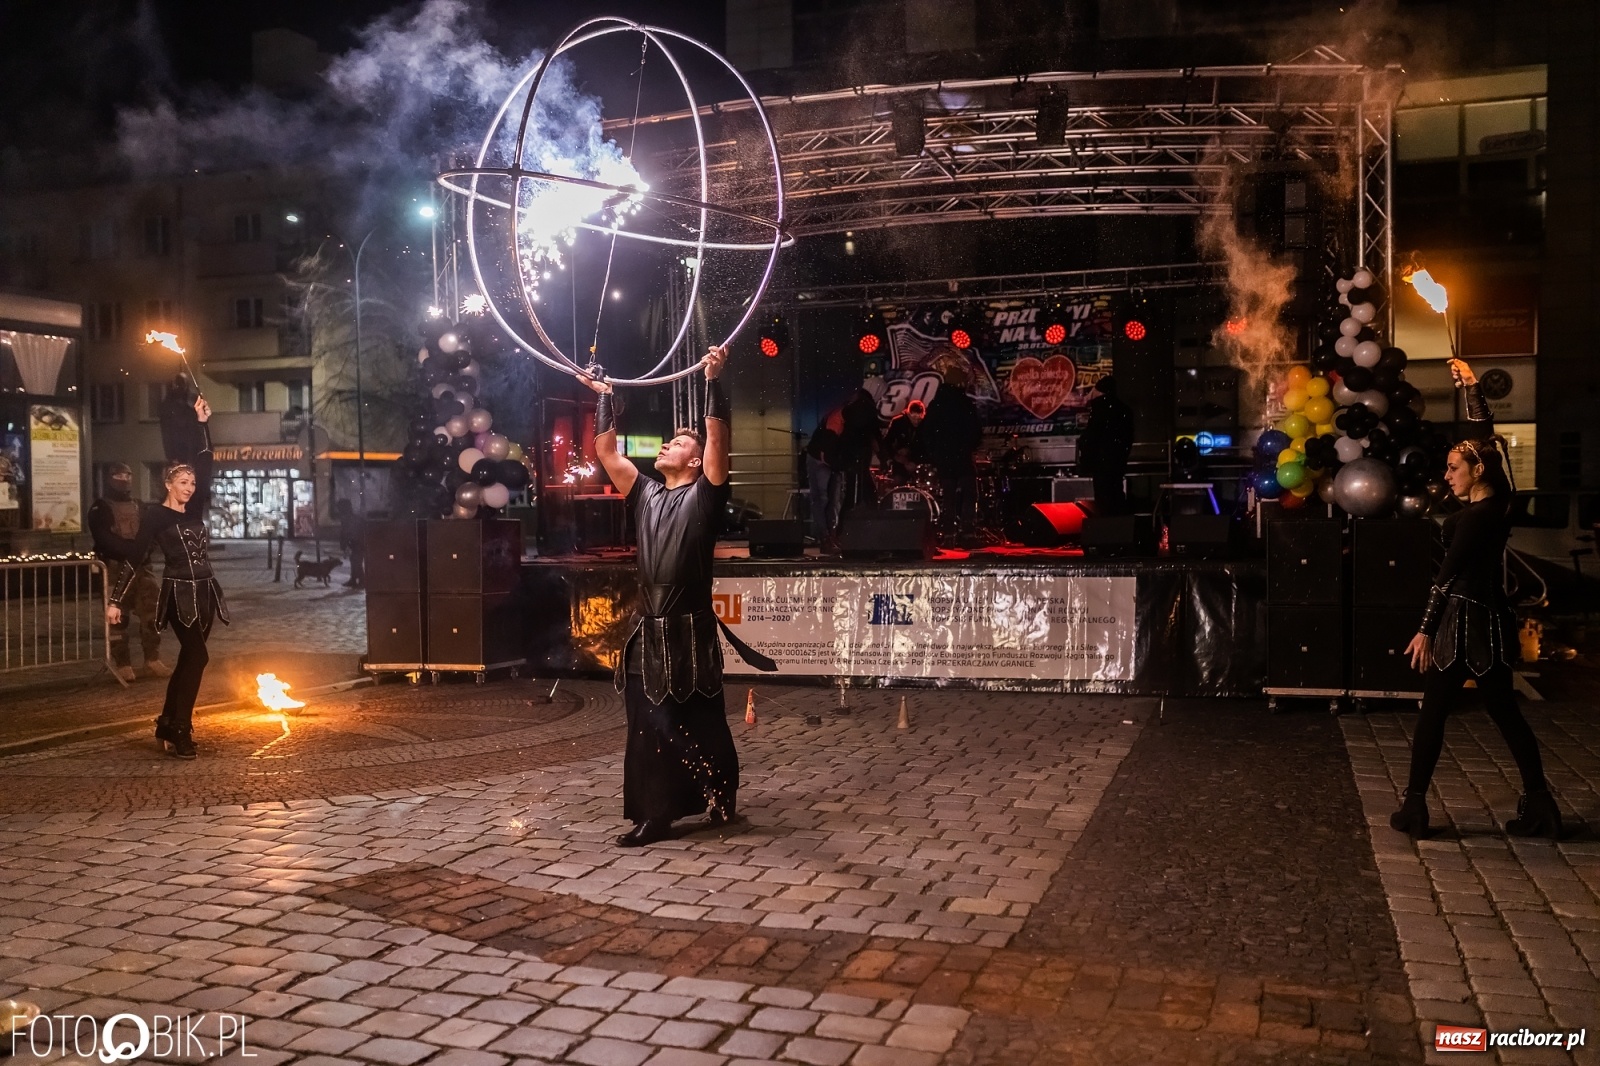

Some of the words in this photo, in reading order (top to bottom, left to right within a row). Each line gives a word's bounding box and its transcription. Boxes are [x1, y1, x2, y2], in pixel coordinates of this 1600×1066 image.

[999, 326, 1025, 343] NA
[879, 375, 940, 417] 30
[787, 641, 826, 650] organizacja
[817, 649, 829, 657] jest
[992, 651, 1028, 659] Funduszu
[1030, 652, 1062, 660] Rozwoju
[801, 658, 828, 666] Interreg
[1000, 660, 1037, 668] GRANICE.
